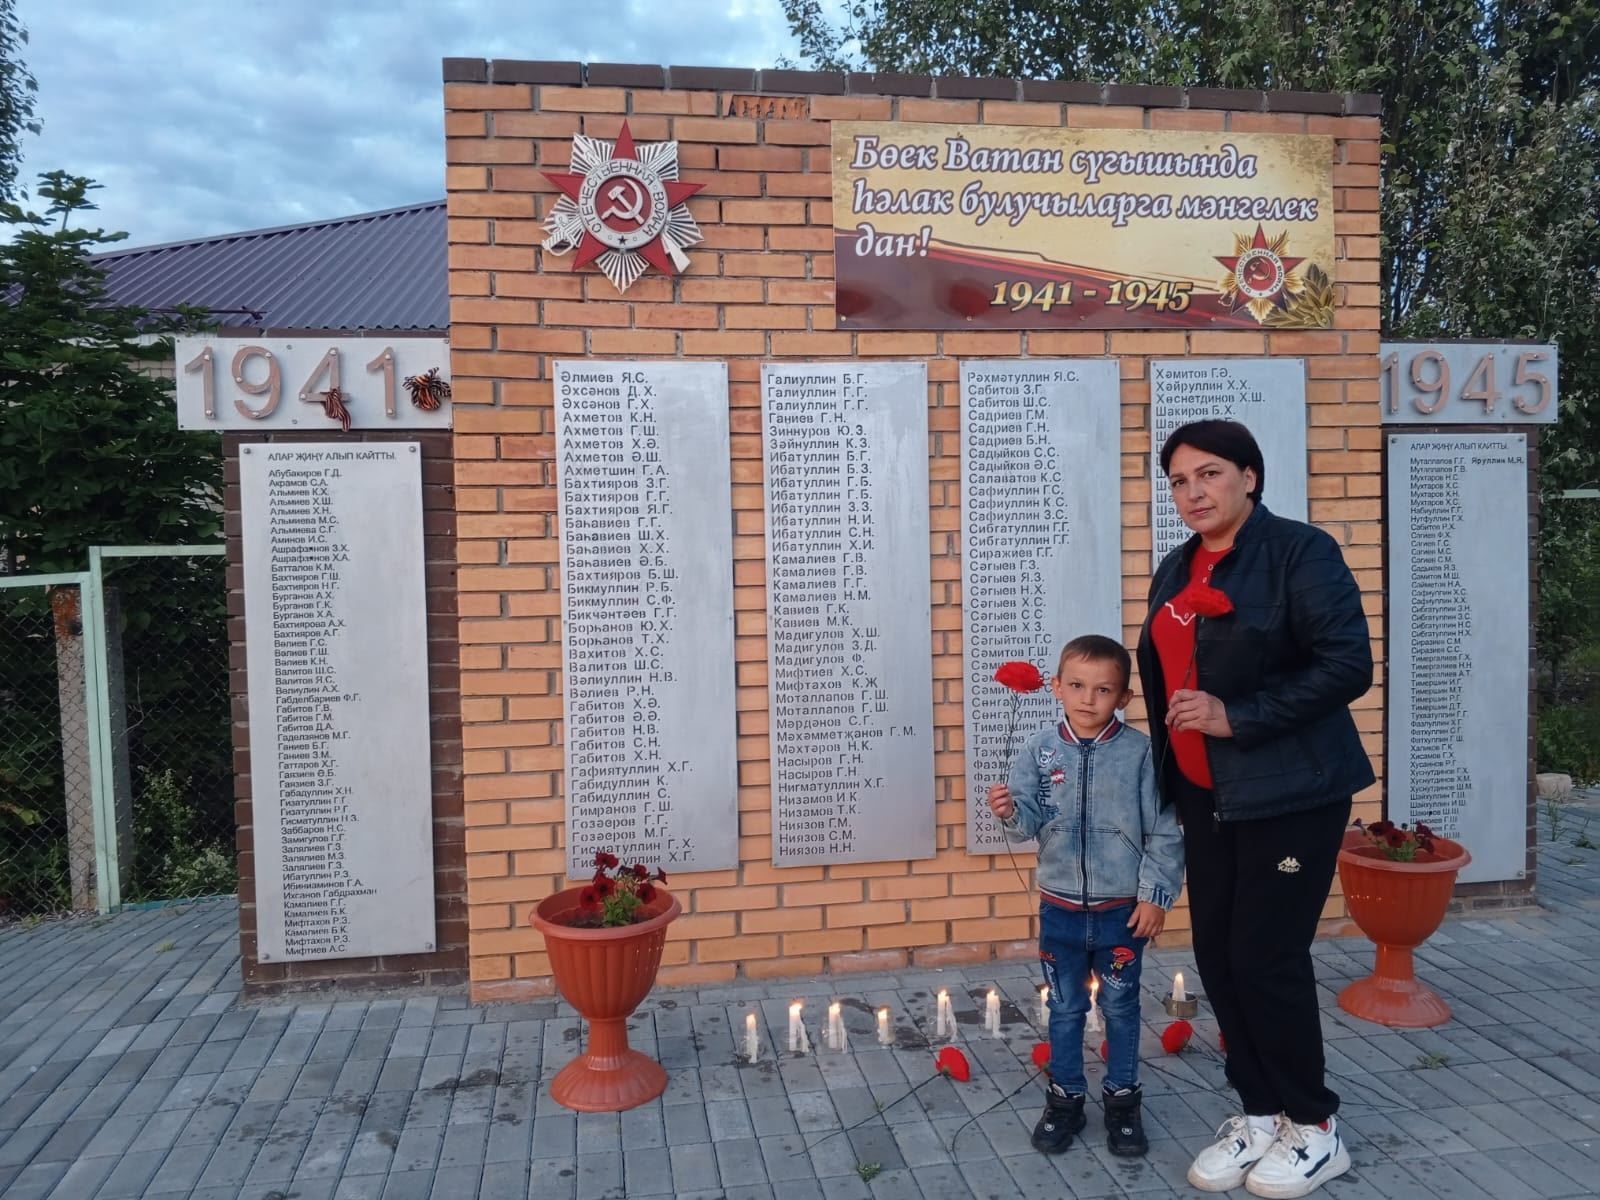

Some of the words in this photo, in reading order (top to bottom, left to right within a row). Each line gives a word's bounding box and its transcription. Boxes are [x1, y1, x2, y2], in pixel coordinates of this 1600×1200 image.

[851, 135, 939, 169] Бөек
[943, 137, 1063, 174] Ватан
[1070, 143, 1258, 184] сүгышында
[582, 162, 655, 233] ОТЕЧЕСТВЕННАЯ
[852, 177, 954, 215] һәлак
[959, 179, 1172, 226] булучыларга
[1176, 193, 1319, 222] мәнгелек
[855, 222, 932, 258] дан!
[990, 280, 1074, 312] 1941
[1104, 280, 1194, 314] 1945
[184, 344, 397, 420] 1941
[1381, 350, 1551, 415] 1945
[560, 371, 613, 382] Әлмиев
[767, 373, 836, 386] Галиуллин
[967, 372, 1049, 384] Рәхмәтуллин
[968, 397, 1019, 407] Сабитов
[563, 411, 622, 422] Ахметов
[968, 422, 1022, 435] Садриев
[563, 438, 623, 449] Ахметов
[770, 438, 839, 451] Зәйнуллин
[968, 435, 1022, 447] Садриев
[564, 451, 623, 462] Ахметов
[770, 451, 839, 464] Ибатуллин
[968, 447, 1030, 460] Садыйков
[564, 477, 638, 490] Бахтияров
[770, 477, 840, 489] Ибатуллин
[564, 491, 638, 503] Бахтияров
[771, 502, 840, 515] Ибатуллин
[968, 509, 1040, 523] Сафиуллин
[565, 517, 630, 528] Баһавиев
[969, 522, 1049, 535] Сибгатуллин
[771, 528, 841, 540] Ибатуллин
[772, 541, 841, 553] Ибатуллин
[969, 535, 1049, 548] Сибгатуллин
[566, 556, 631, 568] Баһавиев
[969, 573, 1016, 584] Сәгыев
[970, 585, 1016, 596] Сәгыев
[567, 596, 639, 608] Бикмуллин
[970, 598, 1016, 608] Сәгыев
[773, 605, 819, 615] Кавиев
[970, 647, 1024, 658] Сәмитов
[569, 661, 626, 672] Валитов
[775, 667, 833, 680] Мифтиев
[570, 700, 624, 711] Габитов
[570, 726, 625, 737] Габитов
[570, 739, 625, 751] Габитов
[570, 752, 625, 764] Габитов
[778, 781, 859, 792] Нигматуллин
[779, 820, 824, 830] Ниязов
[779, 833, 824, 843] Ниязов
[779, 845, 824, 856] Ниязов
